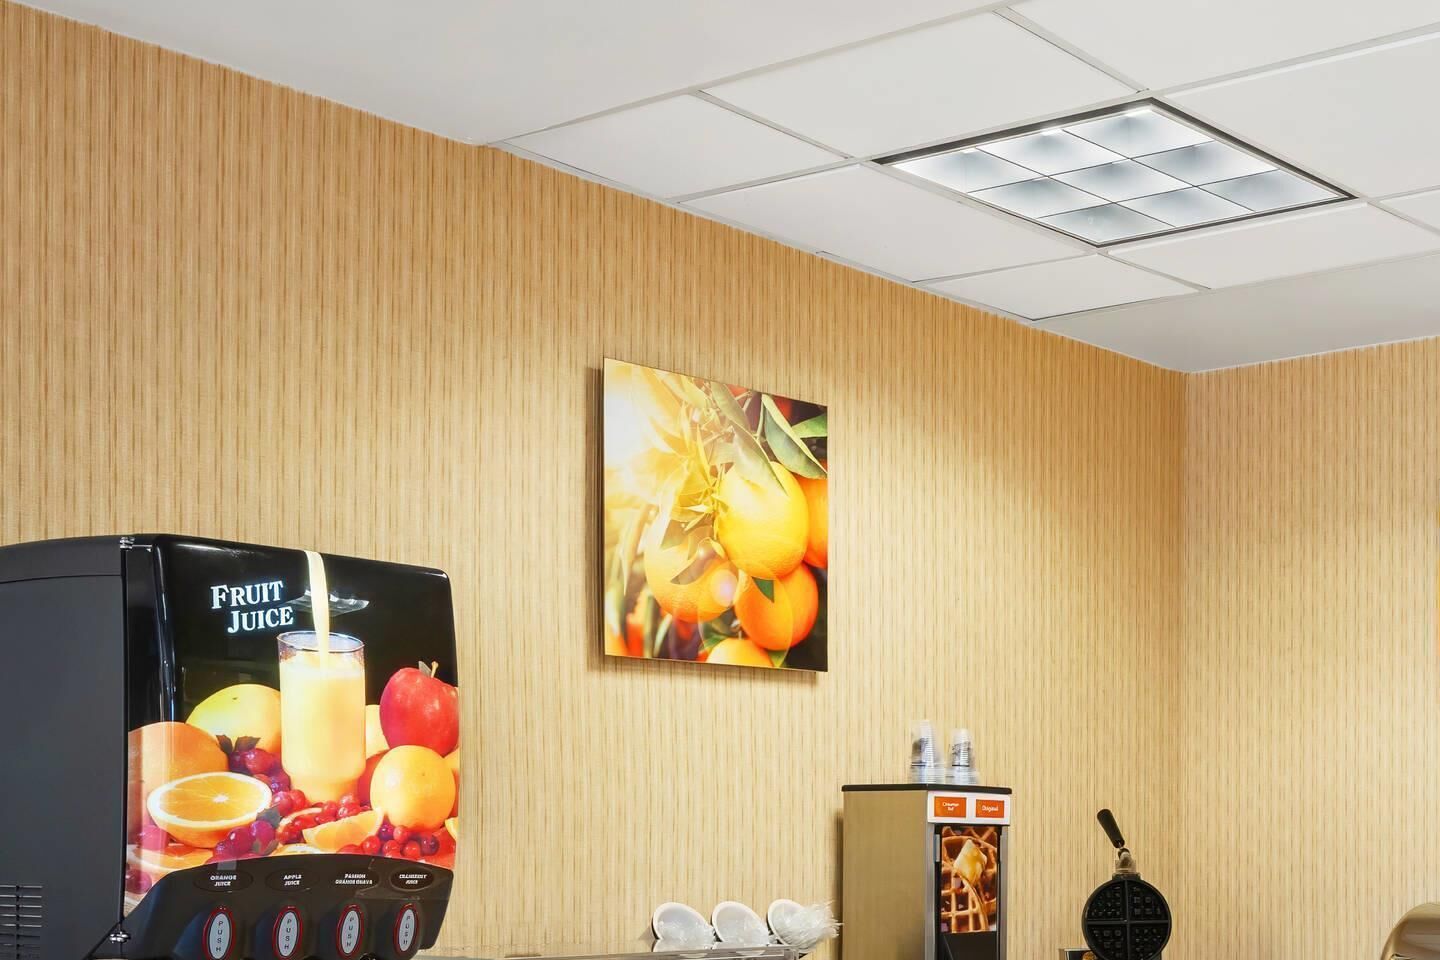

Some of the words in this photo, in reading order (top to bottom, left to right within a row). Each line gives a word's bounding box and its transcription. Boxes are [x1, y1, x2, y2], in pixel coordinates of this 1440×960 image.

[210, 580, 284, 609] FRUIT
[227, 606, 294, 634] JUICE
[284, 918, 292, 949] PUSH
[346, 917, 354, 947] PUSH
[403, 915, 411, 944] PUSH
